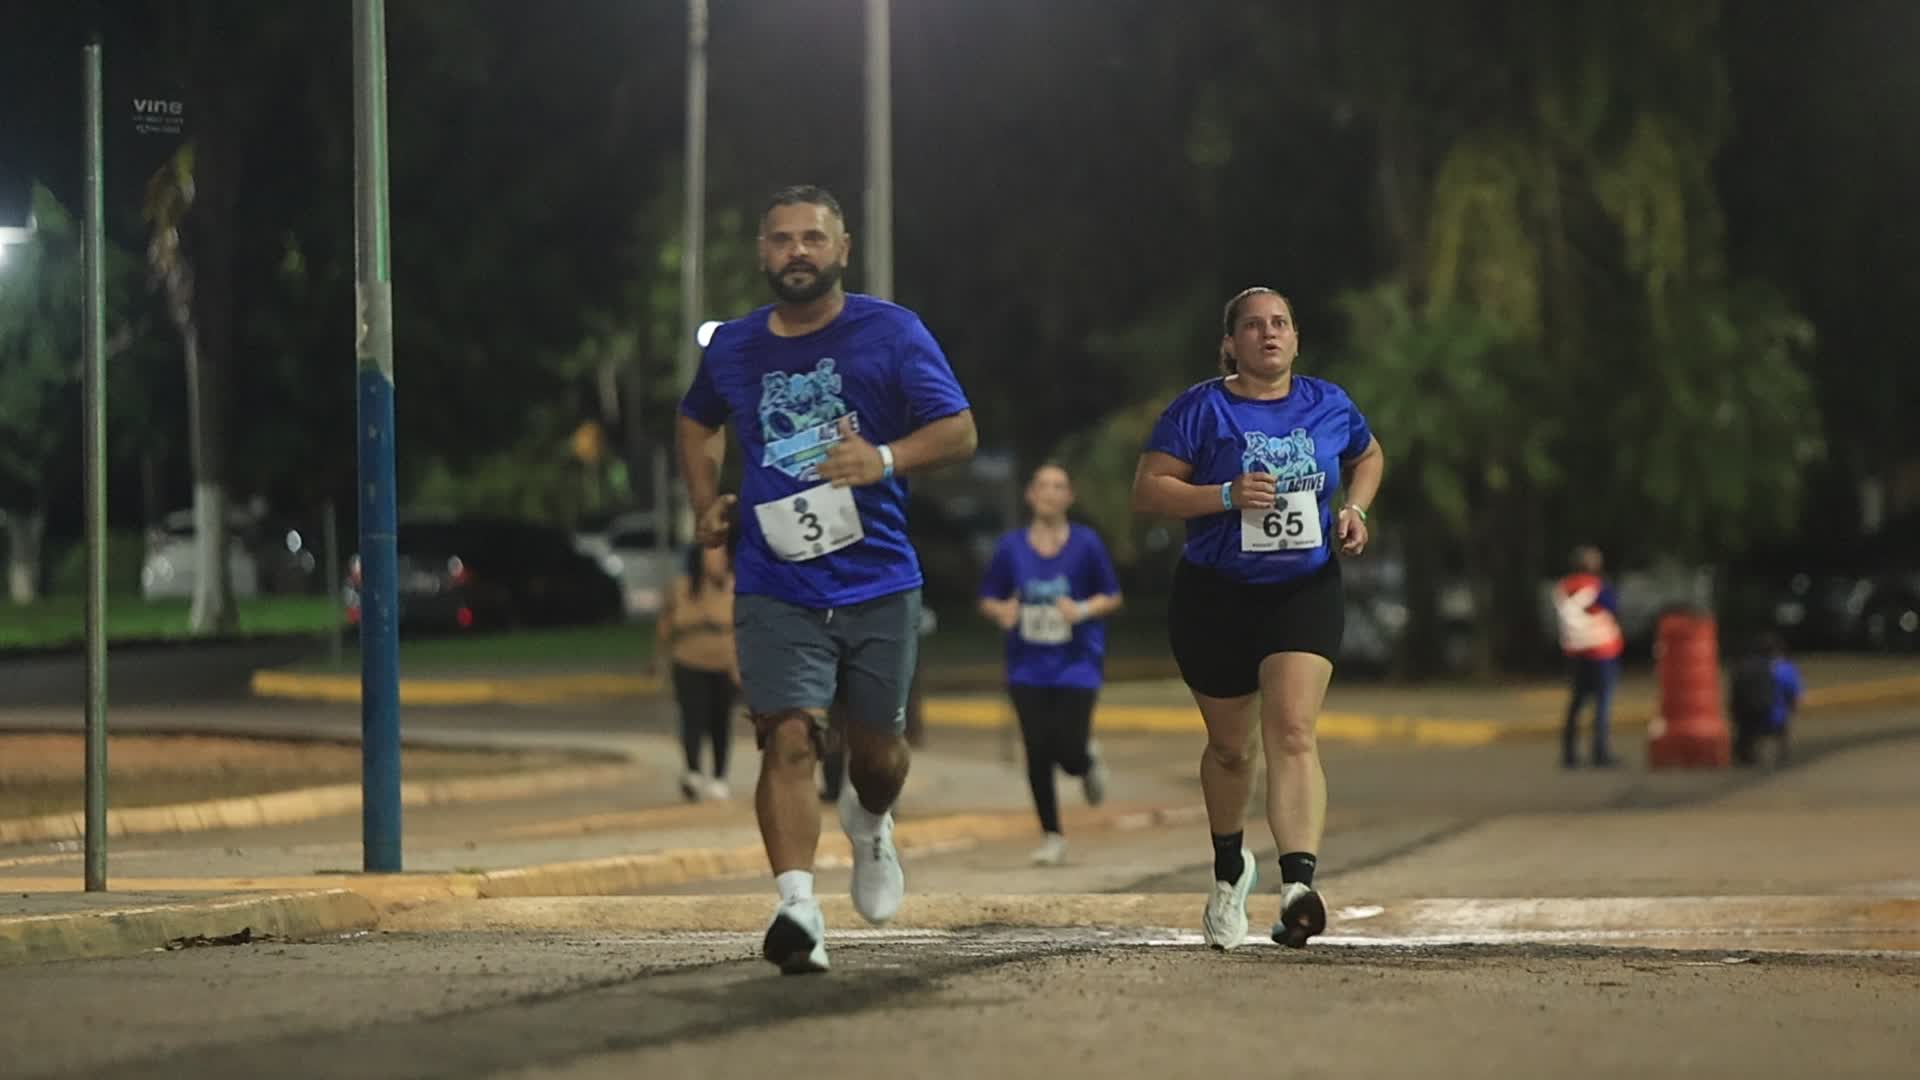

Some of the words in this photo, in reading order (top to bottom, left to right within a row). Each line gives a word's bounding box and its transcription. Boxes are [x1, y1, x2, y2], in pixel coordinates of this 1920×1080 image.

[1287, 475, 1323, 493] ACTIVE
[798, 512, 824, 542] 3
[1263, 511, 1304, 538] 65
